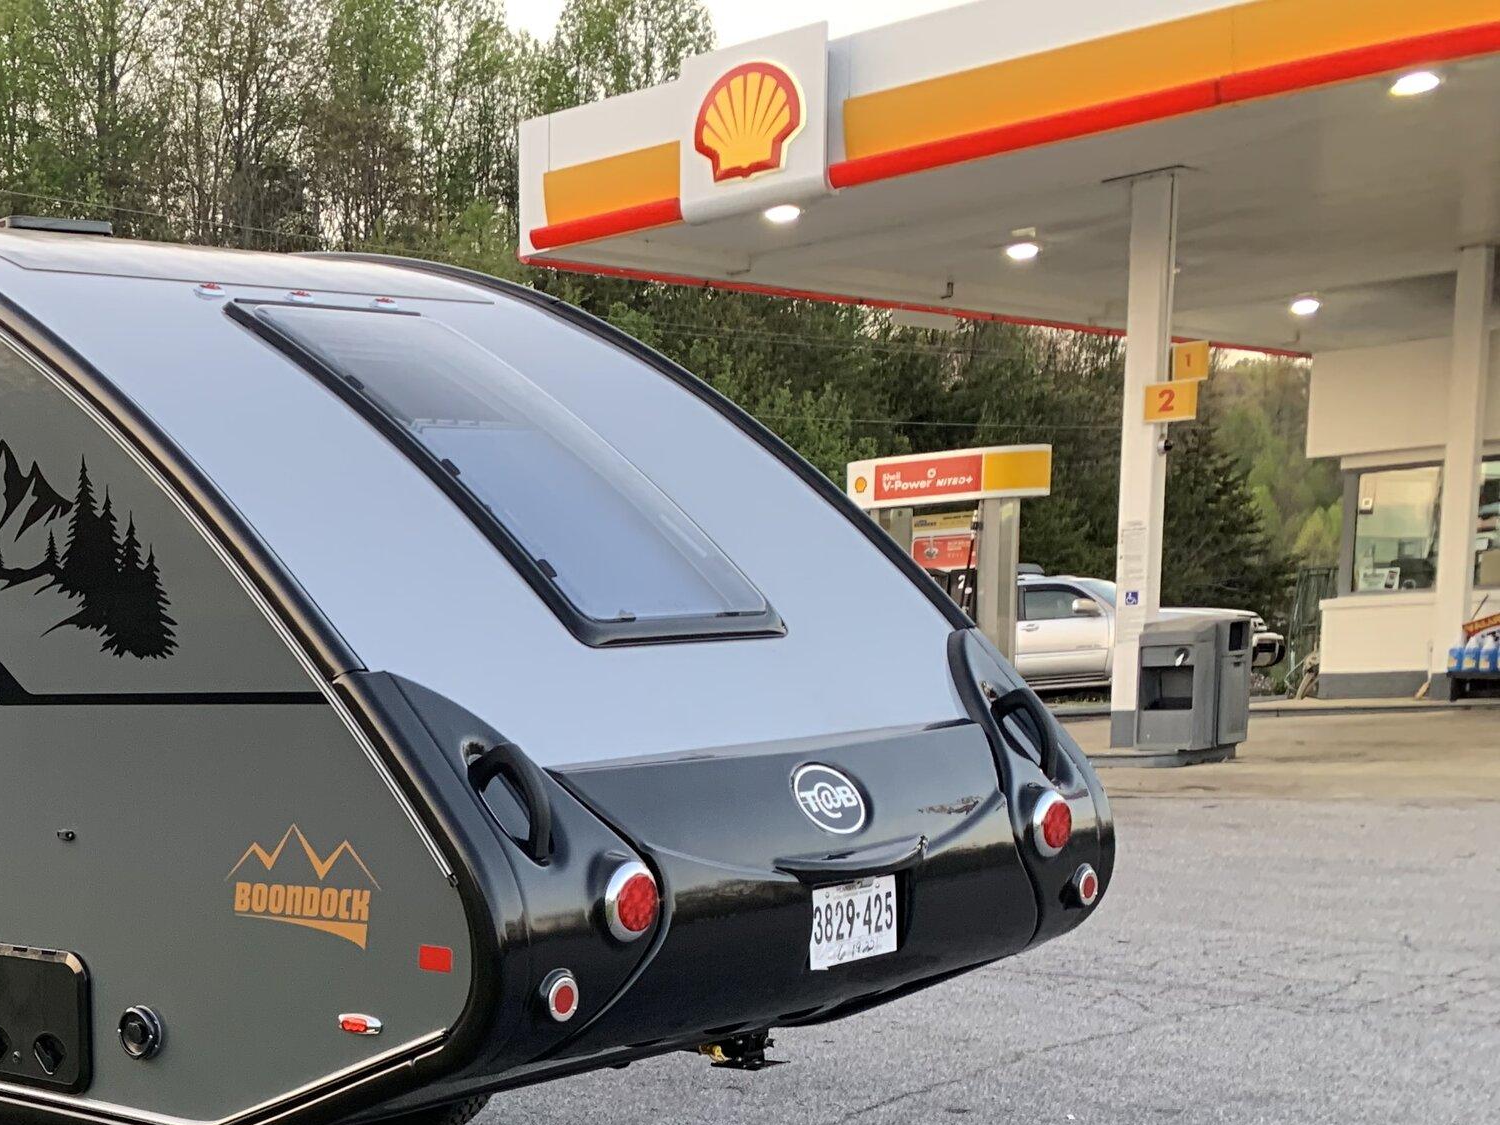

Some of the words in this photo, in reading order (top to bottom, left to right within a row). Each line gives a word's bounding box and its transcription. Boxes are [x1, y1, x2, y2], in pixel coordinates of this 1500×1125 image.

[1185, 353, 1191, 368] 1
[1158, 389, 1175, 412] 2
[882, 471, 901, 481] Shell
[882, 479, 933, 492] V-Power
[799, 782, 858, 818] T@B
[234, 881, 371, 921] BOONDOCK
